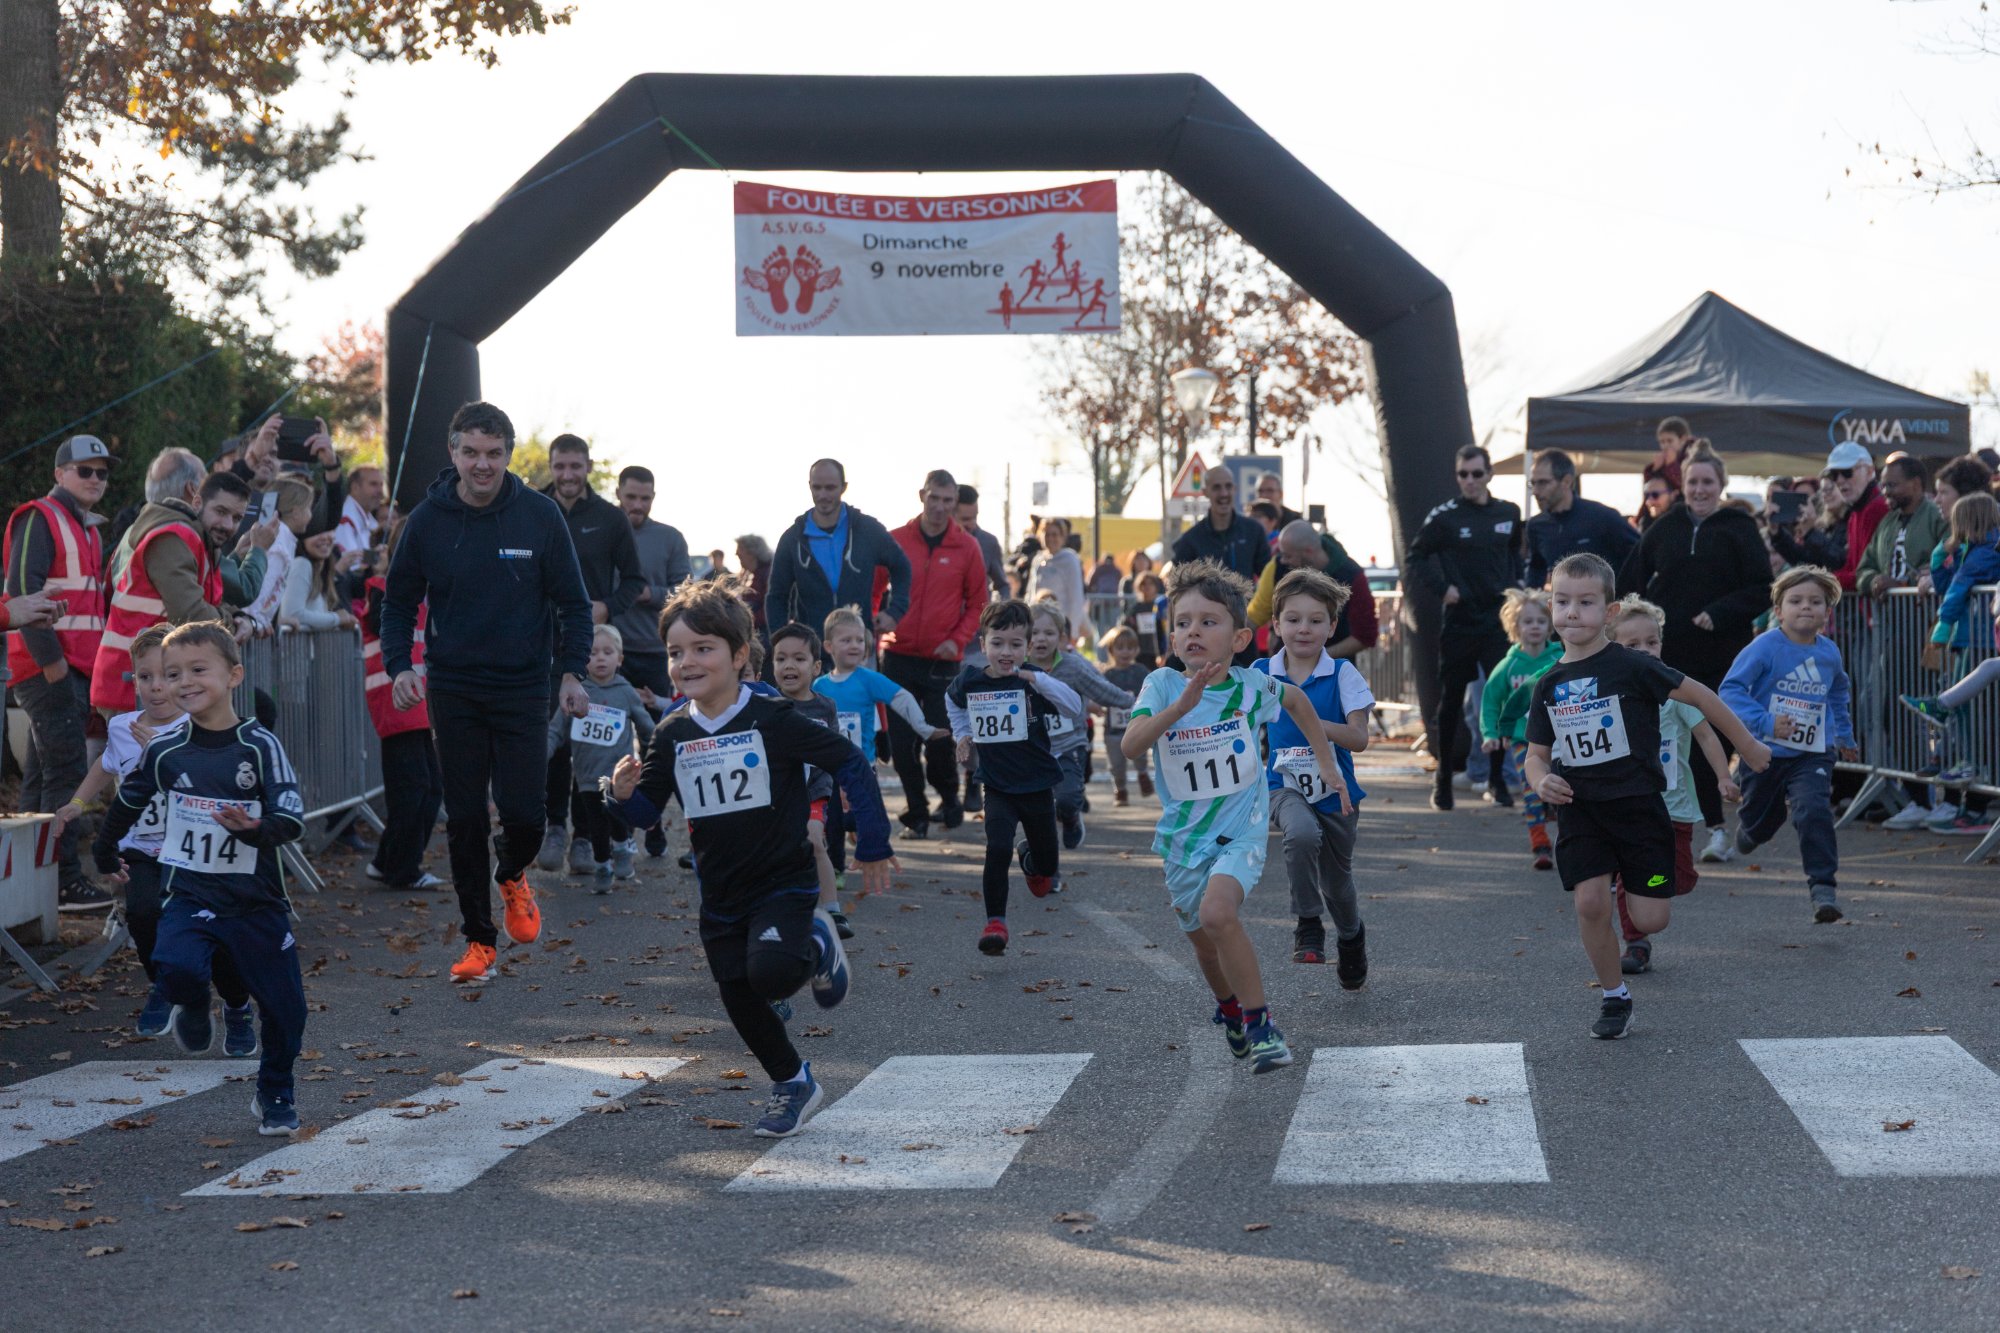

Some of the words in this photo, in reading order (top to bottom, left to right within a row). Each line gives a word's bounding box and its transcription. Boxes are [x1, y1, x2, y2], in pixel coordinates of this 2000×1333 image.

[767, 188, 867, 217] FOULÉE
[873, 200, 910, 219] DE
[916, 187, 1084, 219] VERSONNEX
[863, 233, 968, 250] Dimanche
[870, 261, 884, 279] 9
[898, 260, 1004, 279] novembre
[1841, 418, 1906, 444] YAKA
[1776, 680, 1827, 695] adidas
[1556, 699, 1611, 716] INTERSPORT
[581, 721, 614, 742] 356
[975, 714, 1015, 737] 284
[1178, 720, 1240, 740] INTERSPORT
[1785, 722, 1817, 745] 56
[685, 733, 753, 754] INTERSPORT
[1196, 744, 1219, 753] Pouilly
[1565, 727, 1613, 760] 154
[703, 757, 725, 766] Pouilly
[1183, 754, 1240, 792] 111
[694, 768, 753, 808] 112
[180, 829, 239, 865] 414
